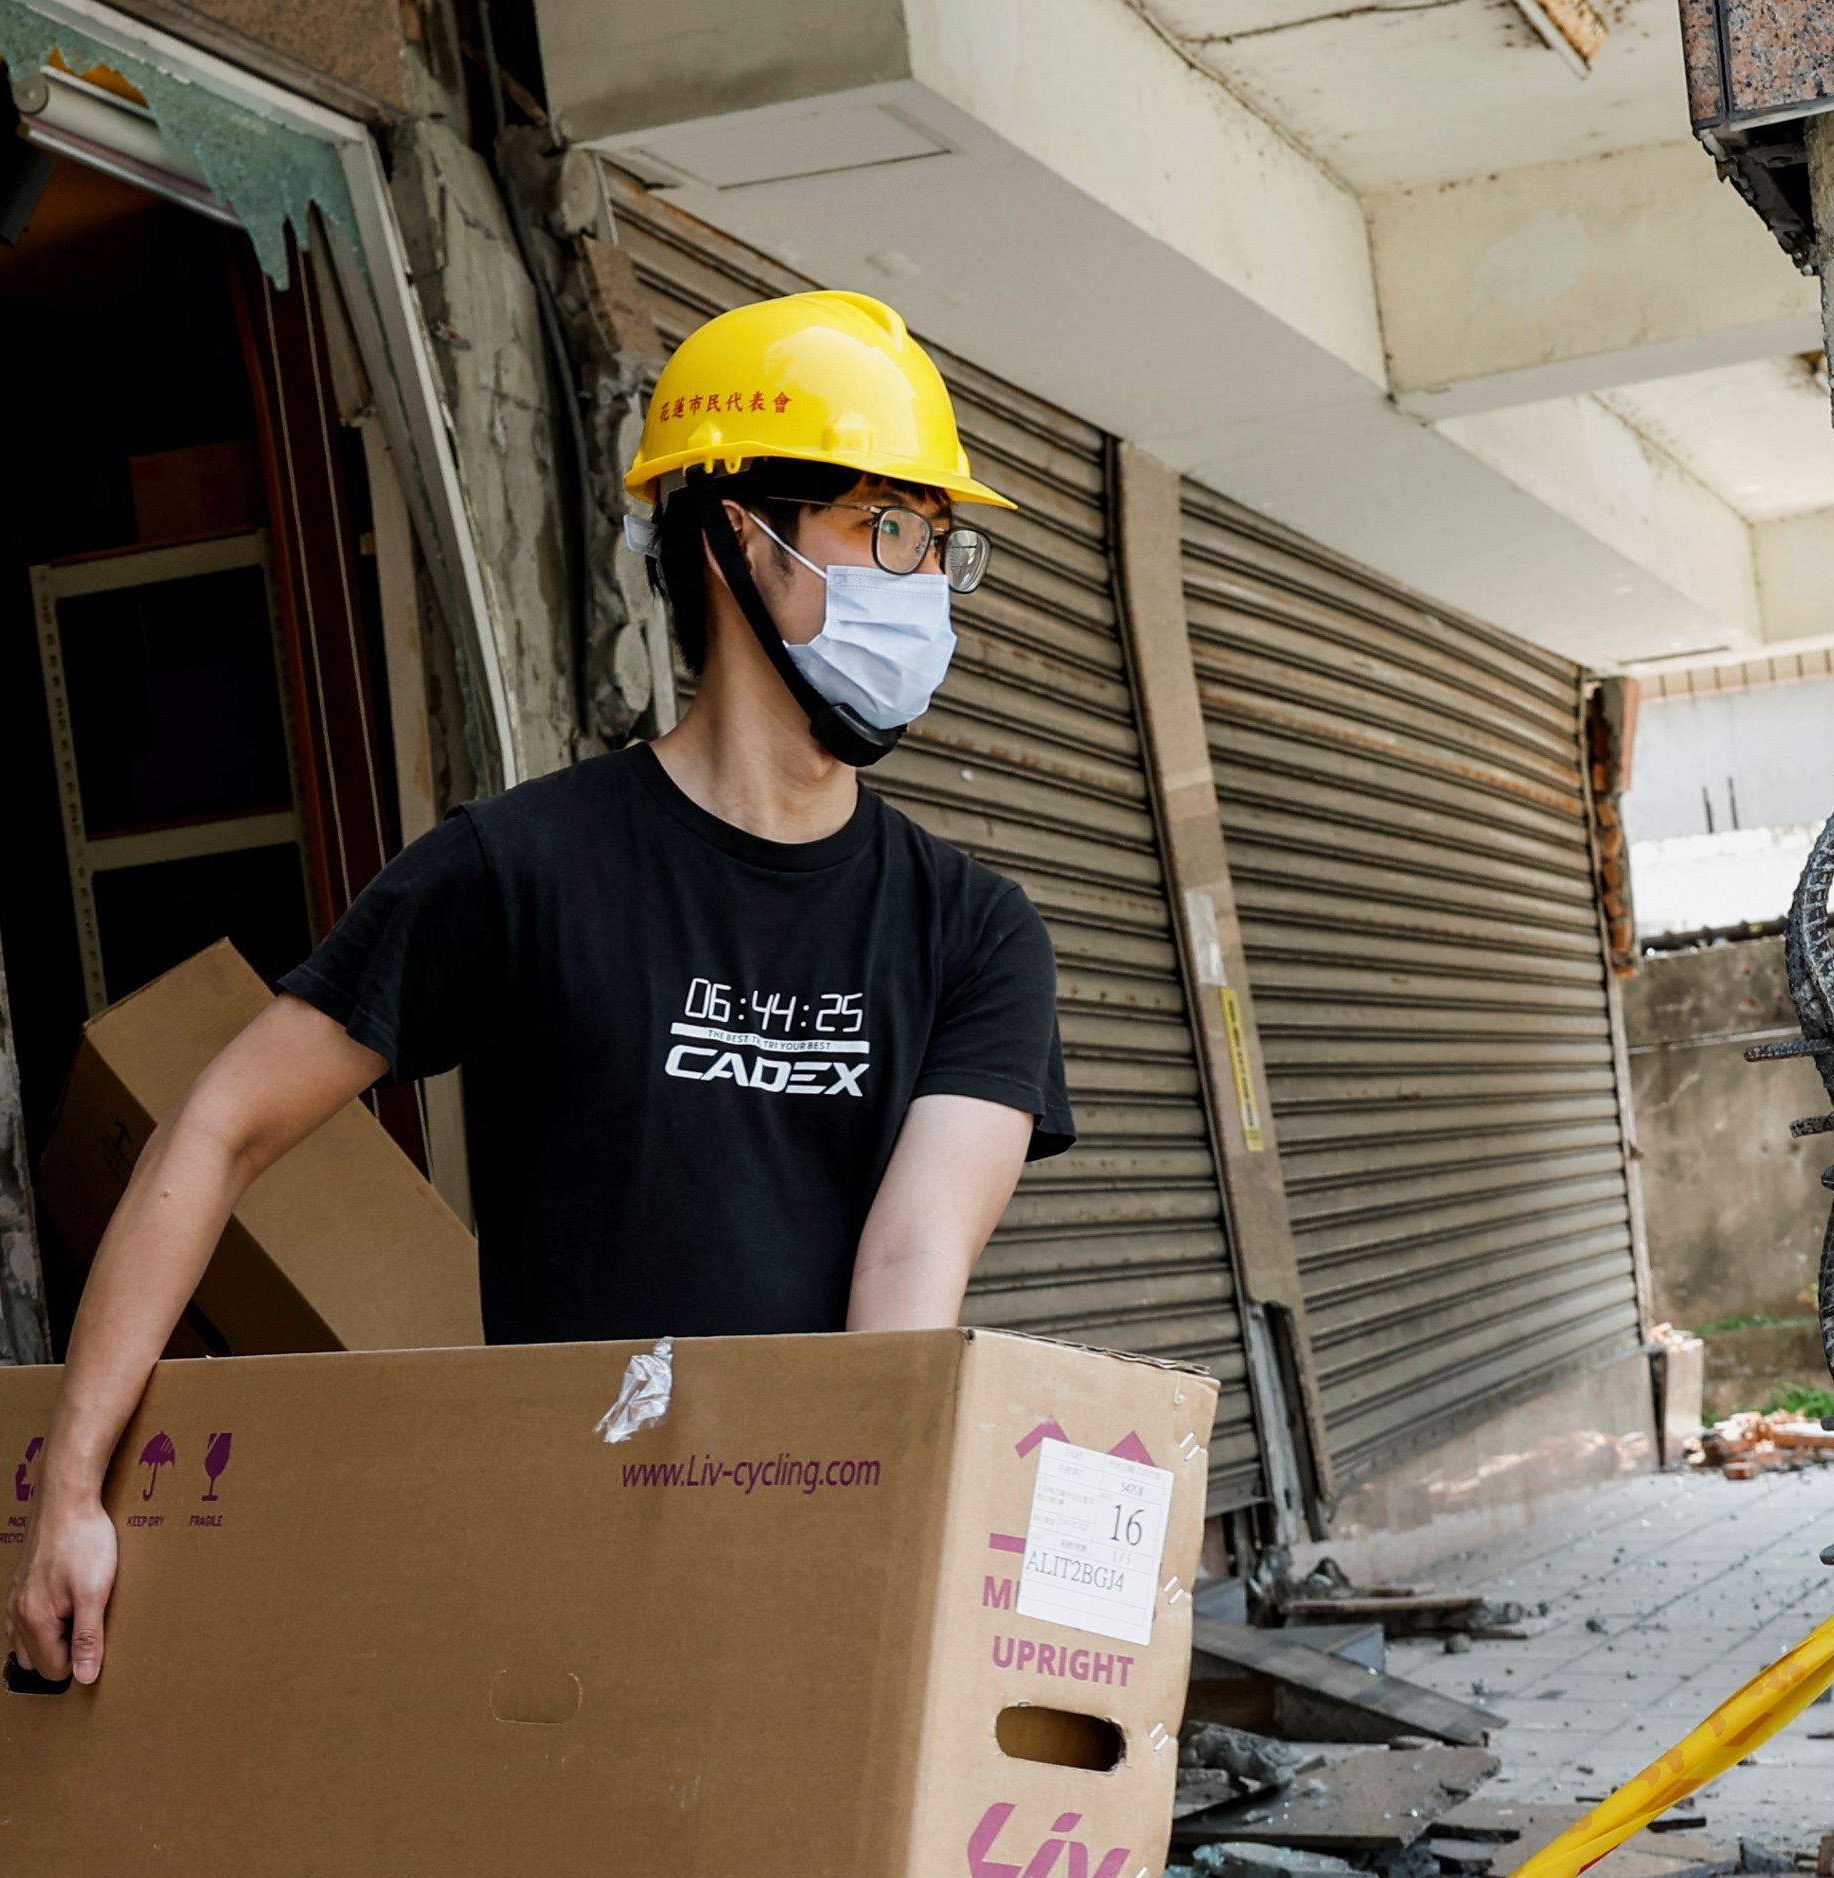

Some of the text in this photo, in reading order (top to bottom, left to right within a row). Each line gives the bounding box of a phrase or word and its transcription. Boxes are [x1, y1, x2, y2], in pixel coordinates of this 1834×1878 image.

[685, 977, 864, 1033] 06:44:25
[708, 1029, 724, 1040] THE
[726, 1033, 749, 1044] BEST
[764, 1040, 778, 1049] TRI
[780, 1041, 806, 1051] YOUR
[807, 1041, 832, 1051] BEST
[664, 1043, 870, 1097] CADEX
[622, 1453, 881, 1495] www.Liv-cycling.com
[127, 1515, 165, 1527] KEEP DRY
[189, 1515, 223, 1527] FRAGILE
[1109, 1503, 1146, 1546] 16
[1026, 1551, 1125, 1593] ALIT2BGJ4
[992, 1635, 1135, 1687] UPRIGHT
